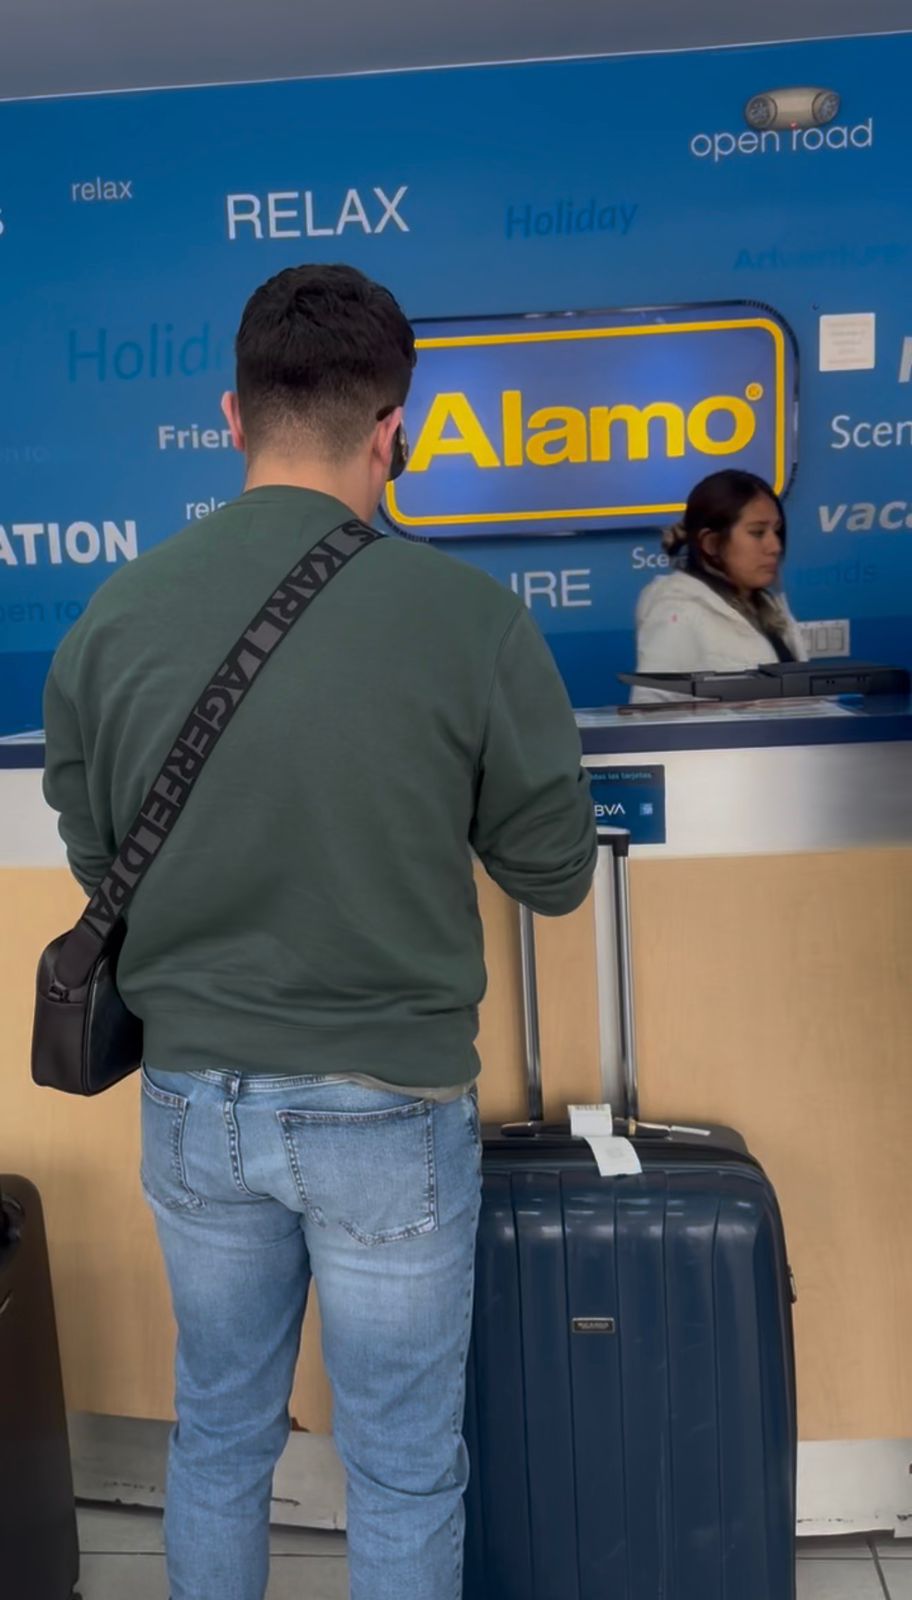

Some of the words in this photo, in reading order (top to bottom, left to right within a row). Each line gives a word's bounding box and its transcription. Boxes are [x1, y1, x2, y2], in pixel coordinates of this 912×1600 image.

[690, 130, 780, 162] open
[791, 117, 873, 151] road
[71, 176, 133, 201] relax
[226, 184, 411, 240] RELAX
[504, 196, 640, 241] Holiday
[631, 546, 675, 569] Sce
[511, 567, 592, 609] RE
